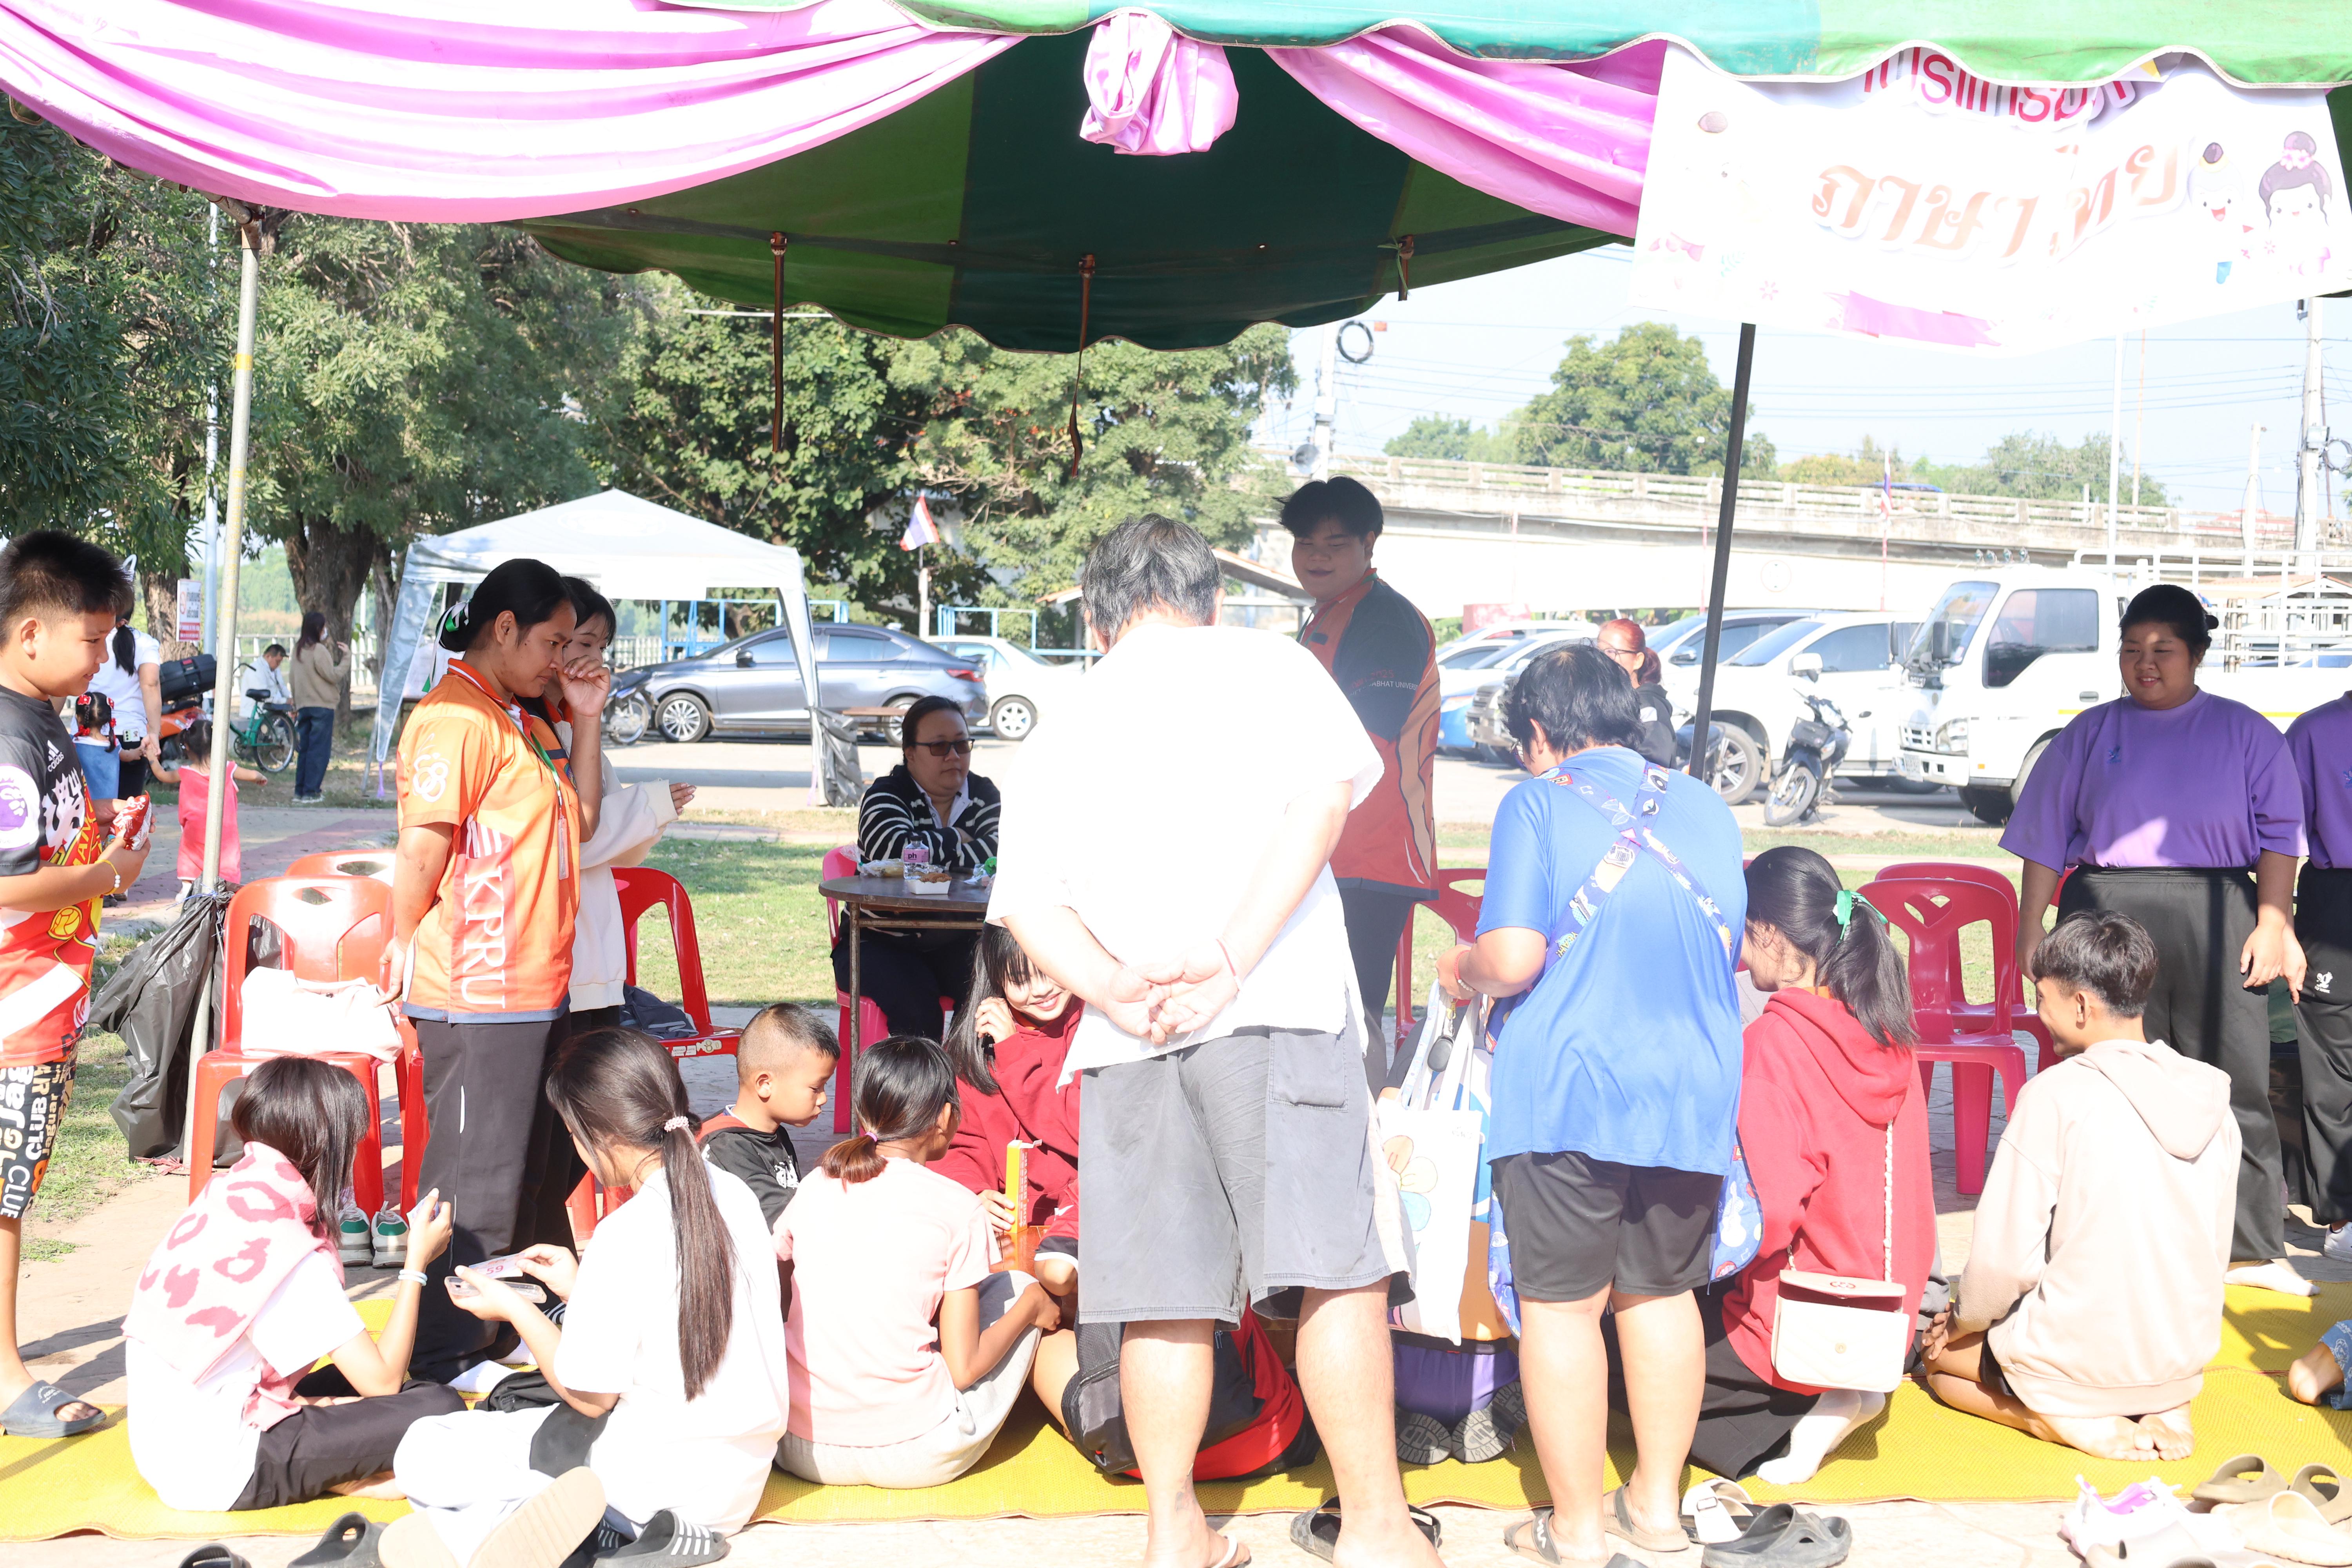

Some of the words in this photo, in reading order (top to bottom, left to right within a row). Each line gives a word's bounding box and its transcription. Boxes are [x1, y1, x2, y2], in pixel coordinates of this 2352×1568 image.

[47, 752, 64, 772] adidas
[461, 865, 506, 1009] KPRU
[25, 1097, 47, 1160] CLUB
[486, 1265, 504, 1275] 59
